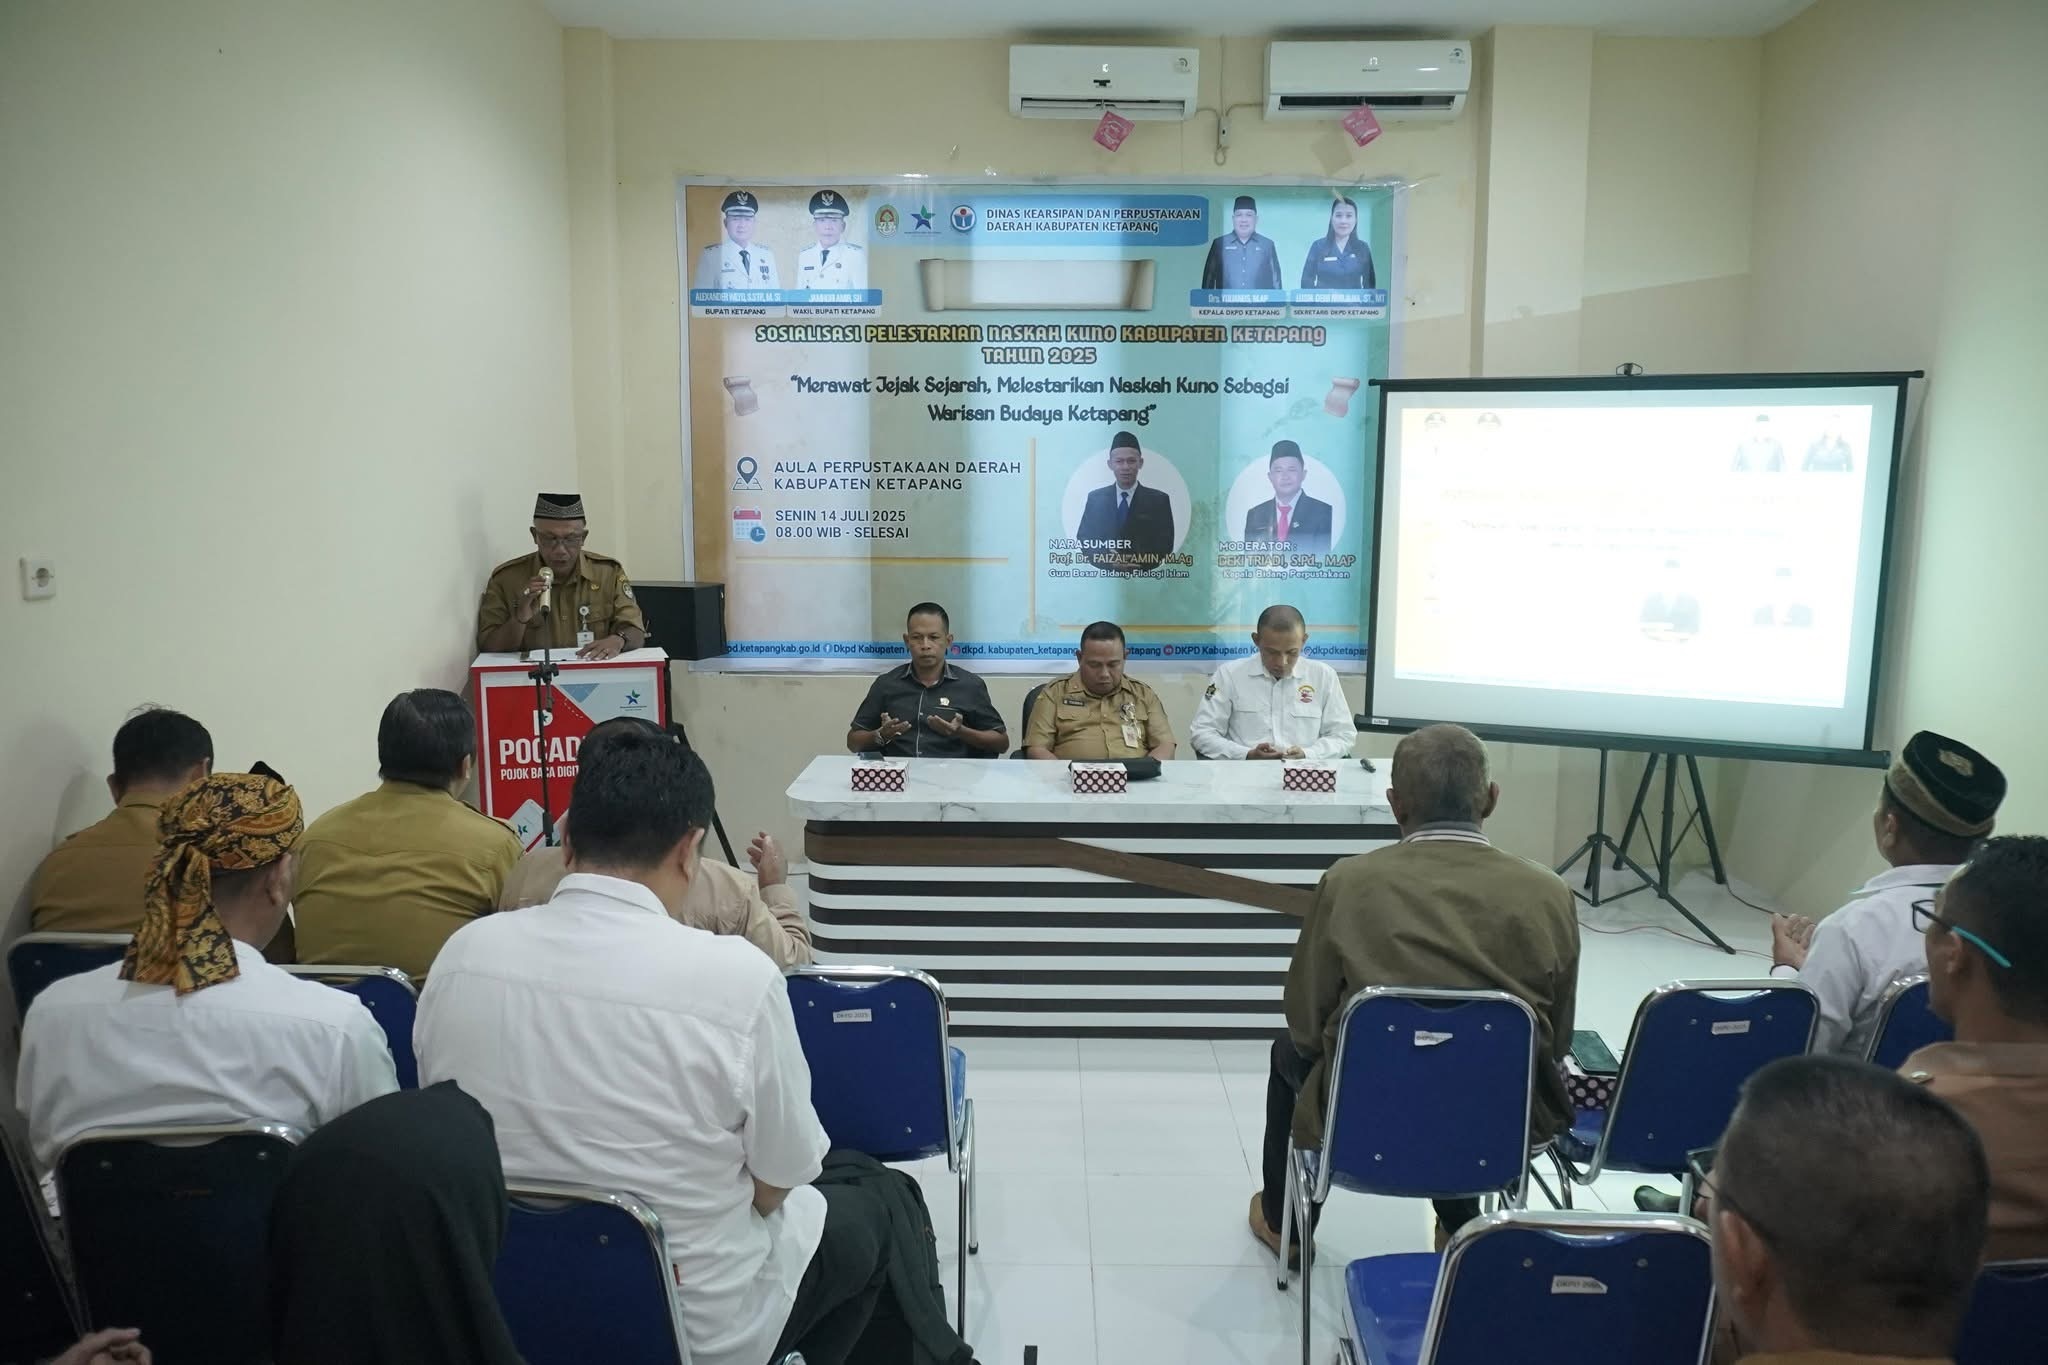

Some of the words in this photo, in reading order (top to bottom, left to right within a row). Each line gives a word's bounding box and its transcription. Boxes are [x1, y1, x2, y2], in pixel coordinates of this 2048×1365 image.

[986, 209, 1020, 219] DINAS
[1023, 209, 1084, 219] KEARSIPAN
[1086, 209, 1111, 219] DAN
[1114, 209, 1200, 219] PERPUSTAKAAN
[986, 222, 1032, 231] DAERAH
[1035, 222, 1099, 231] KABUPATEN
[1102, 222, 1158, 233] KETAPANG
[756, 325, 861, 342] SOSIALISASI
[865, 325, 983, 342] PELESTARIAN
[987, 325, 1061, 342] NASKAH
[1066, 325, 1116, 342] KUNO
[1121, 325, 1228, 342] KABUPATEN
[1231, 325, 1327, 346] KETAPANG
[982, 347, 1045, 364] TAHUN
[1048, 347, 1097, 364] 2025
[791, 375, 871, 393] “Merawat
[876, 376, 919, 396] Jejak
[924, 376, 992, 396] Sejarah,
[997, 376, 1105, 393] Melestarikan
[1109, 376, 1171, 393] Naskah
[1176, 376, 1219, 393] Kuno
[1223, 376, 1290, 398] Sebagai
[927, 404, 994, 421] Warisan
[1000, 404, 1063, 425] Budaya
[1068, 404, 1157, 426] Ketapang”
[774, 462, 817, 473] AULA
[823, 462, 949, 473] PERPUSTAKAAN
[955, 462, 1021, 473] DAERAH
[774, 478, 871, 490] KABUPATEN
[876, 478, 963, 490] KETAPANG
[775, 510, 817, 522] SENIN
[821, 510, 836, 522] 14
[840, 510, 869, 522] JULI
[872, 510, 906, 522] 2025
[775, 526, 813, 538] 08.00
[816, 526, 842, 538] WIB
[854, 526, 909, 538] SELESAI
[1049, 539, 1132, 549] NARASUMBER
[1219, 542, 1291, 551] MODERATOR
[1049, 553, 1073, 566] Prof.
[1076, 553, 1090, 564] Dr.
[1165, 553, 1193, 566] M.Ag
[1218, 555, 1245, 567] DEKI
[1325, 555, 1355, 567] M.AP
[1049, 569, 1070, 577] Guru
[1073, 569, 1098, 577] Besar
[1100, 569, 1130, 579] Bidang
[1132, 569, 1164, 579] Filologi
[1166, 569, 1189, 577] Islam
[1223, 570, 1252, 580] Kepala
[1256, 570, 1287, 580] Bidang
[1289, 570, 1350, 579] Perpustakaan
[834, 643, 856, 655] Dkpd
[859, 643, 905, 656] Kabupaten
[1175, 645, 1199, 655] DKPD
[1202, 645, 1248, 656] Kabupaten
[499, 735, 586, 765] POCAD
[501, 767, 529, 780] POJOK
